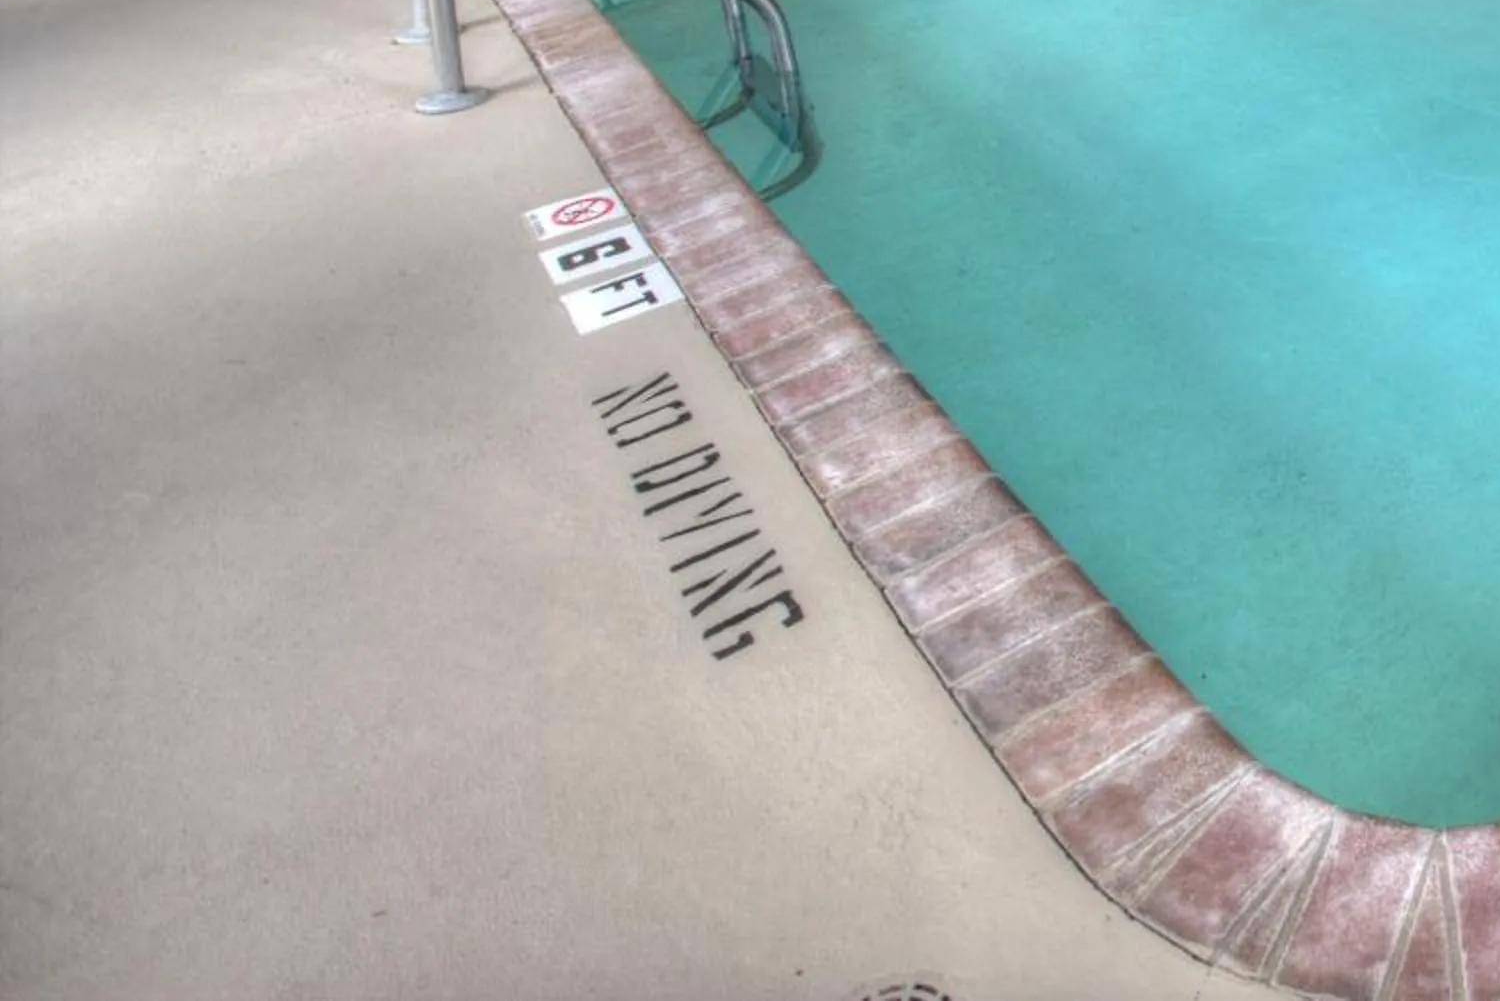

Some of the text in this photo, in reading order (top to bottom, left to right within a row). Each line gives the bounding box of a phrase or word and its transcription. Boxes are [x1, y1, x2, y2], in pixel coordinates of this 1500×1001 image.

[590, 272, 659, 317] FT
[592, 372, 805, 662] NO DIVING
